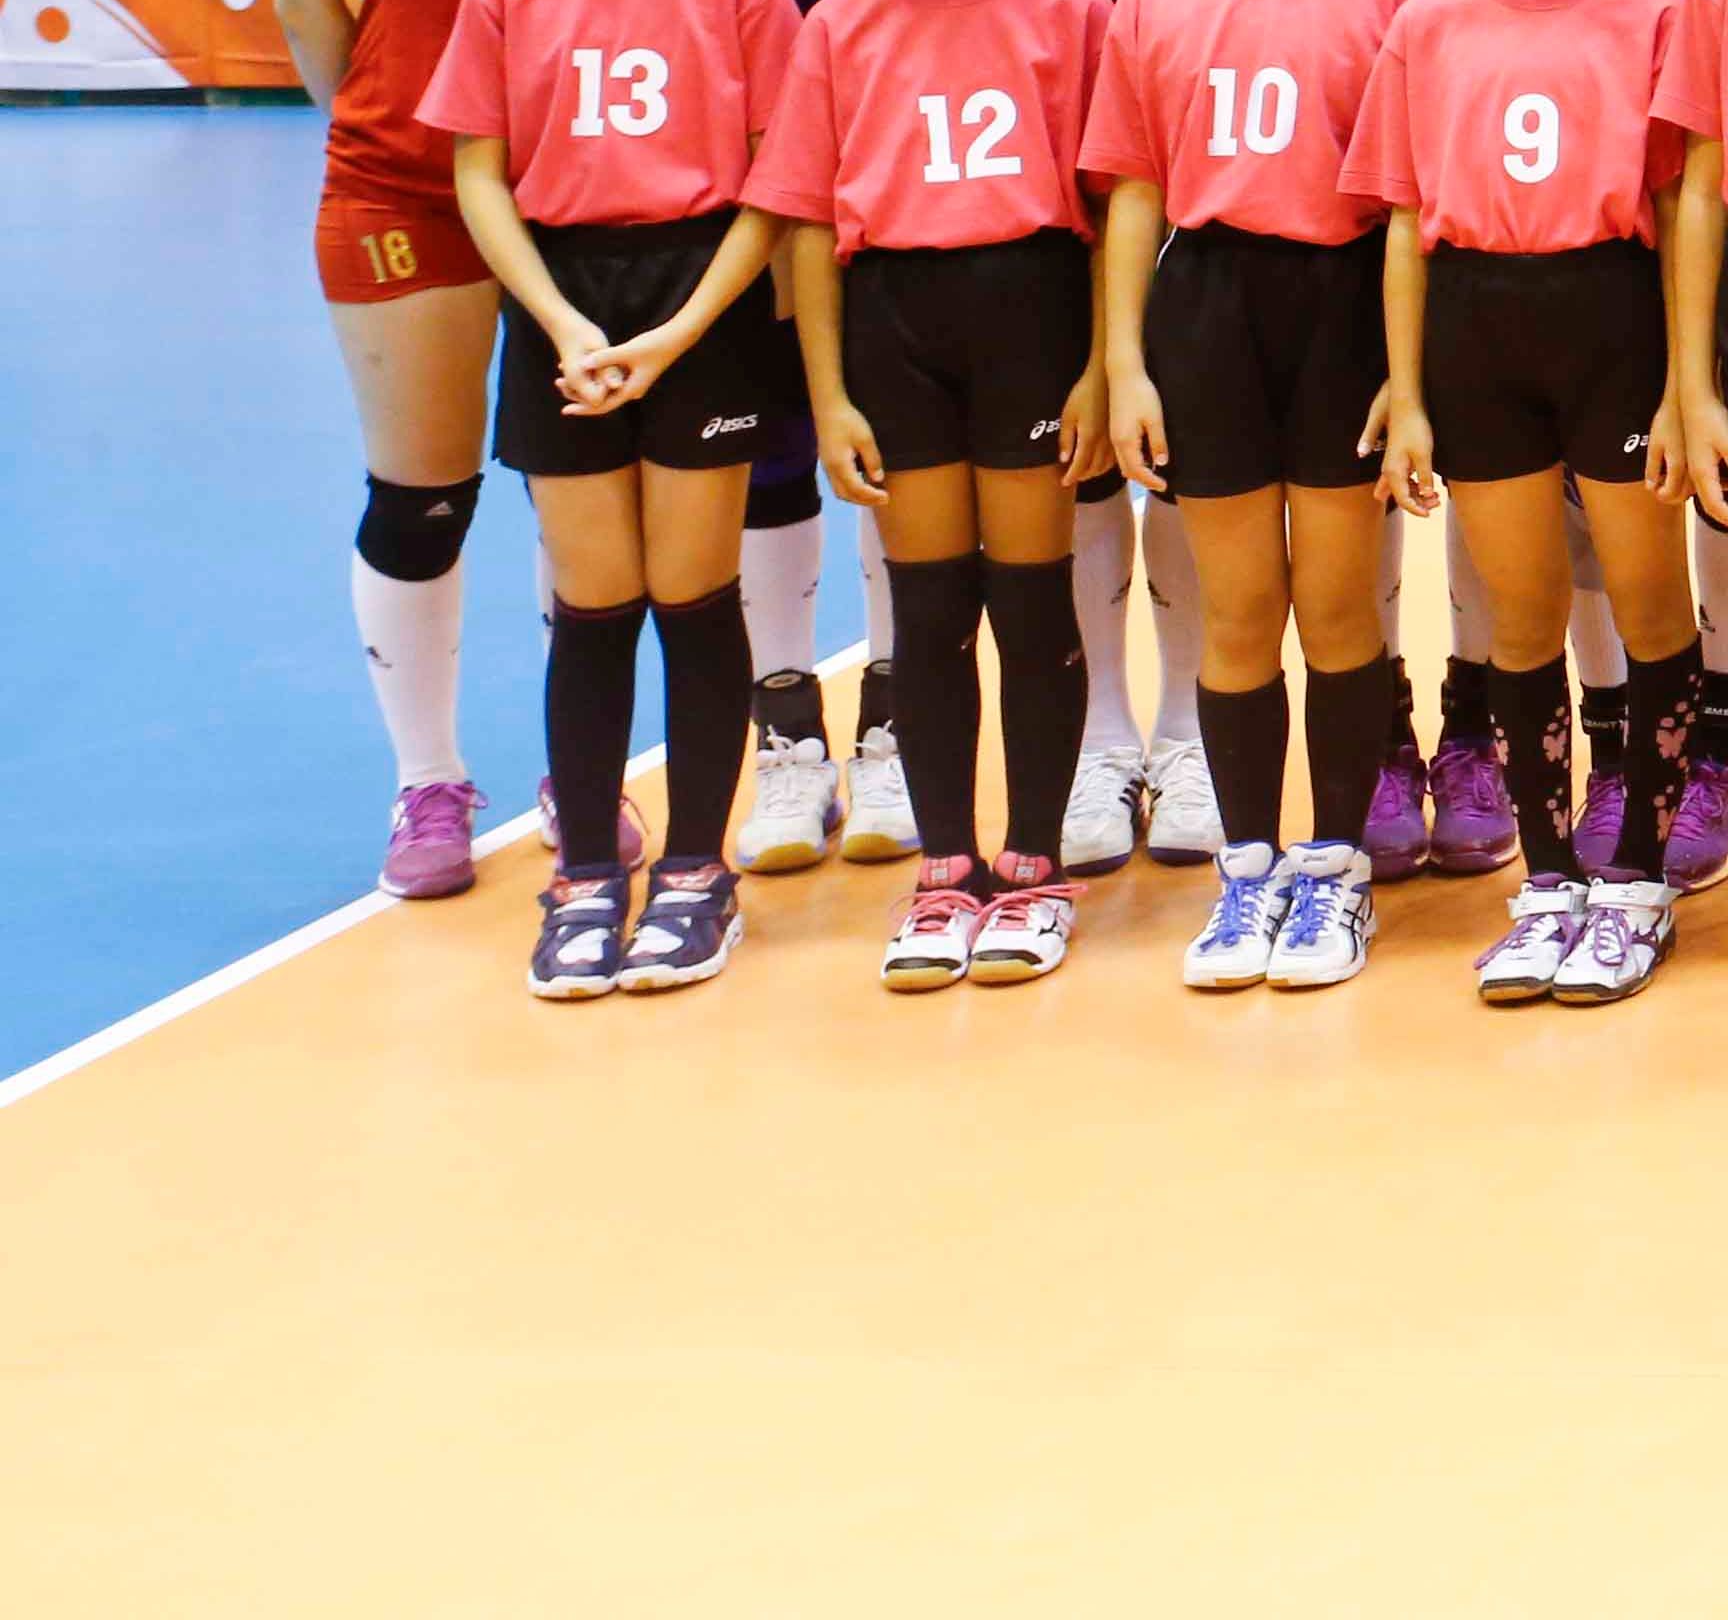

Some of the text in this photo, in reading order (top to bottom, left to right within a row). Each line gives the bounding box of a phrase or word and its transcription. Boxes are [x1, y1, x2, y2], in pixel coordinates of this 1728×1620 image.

[570, 48, 669, 138] 13
[917, 88, 1022, 184] 12
[1206, 66, 1299, 158] 10
[1502, 92, 1560, 184] 9
[362, 229, 417, 285] 18
